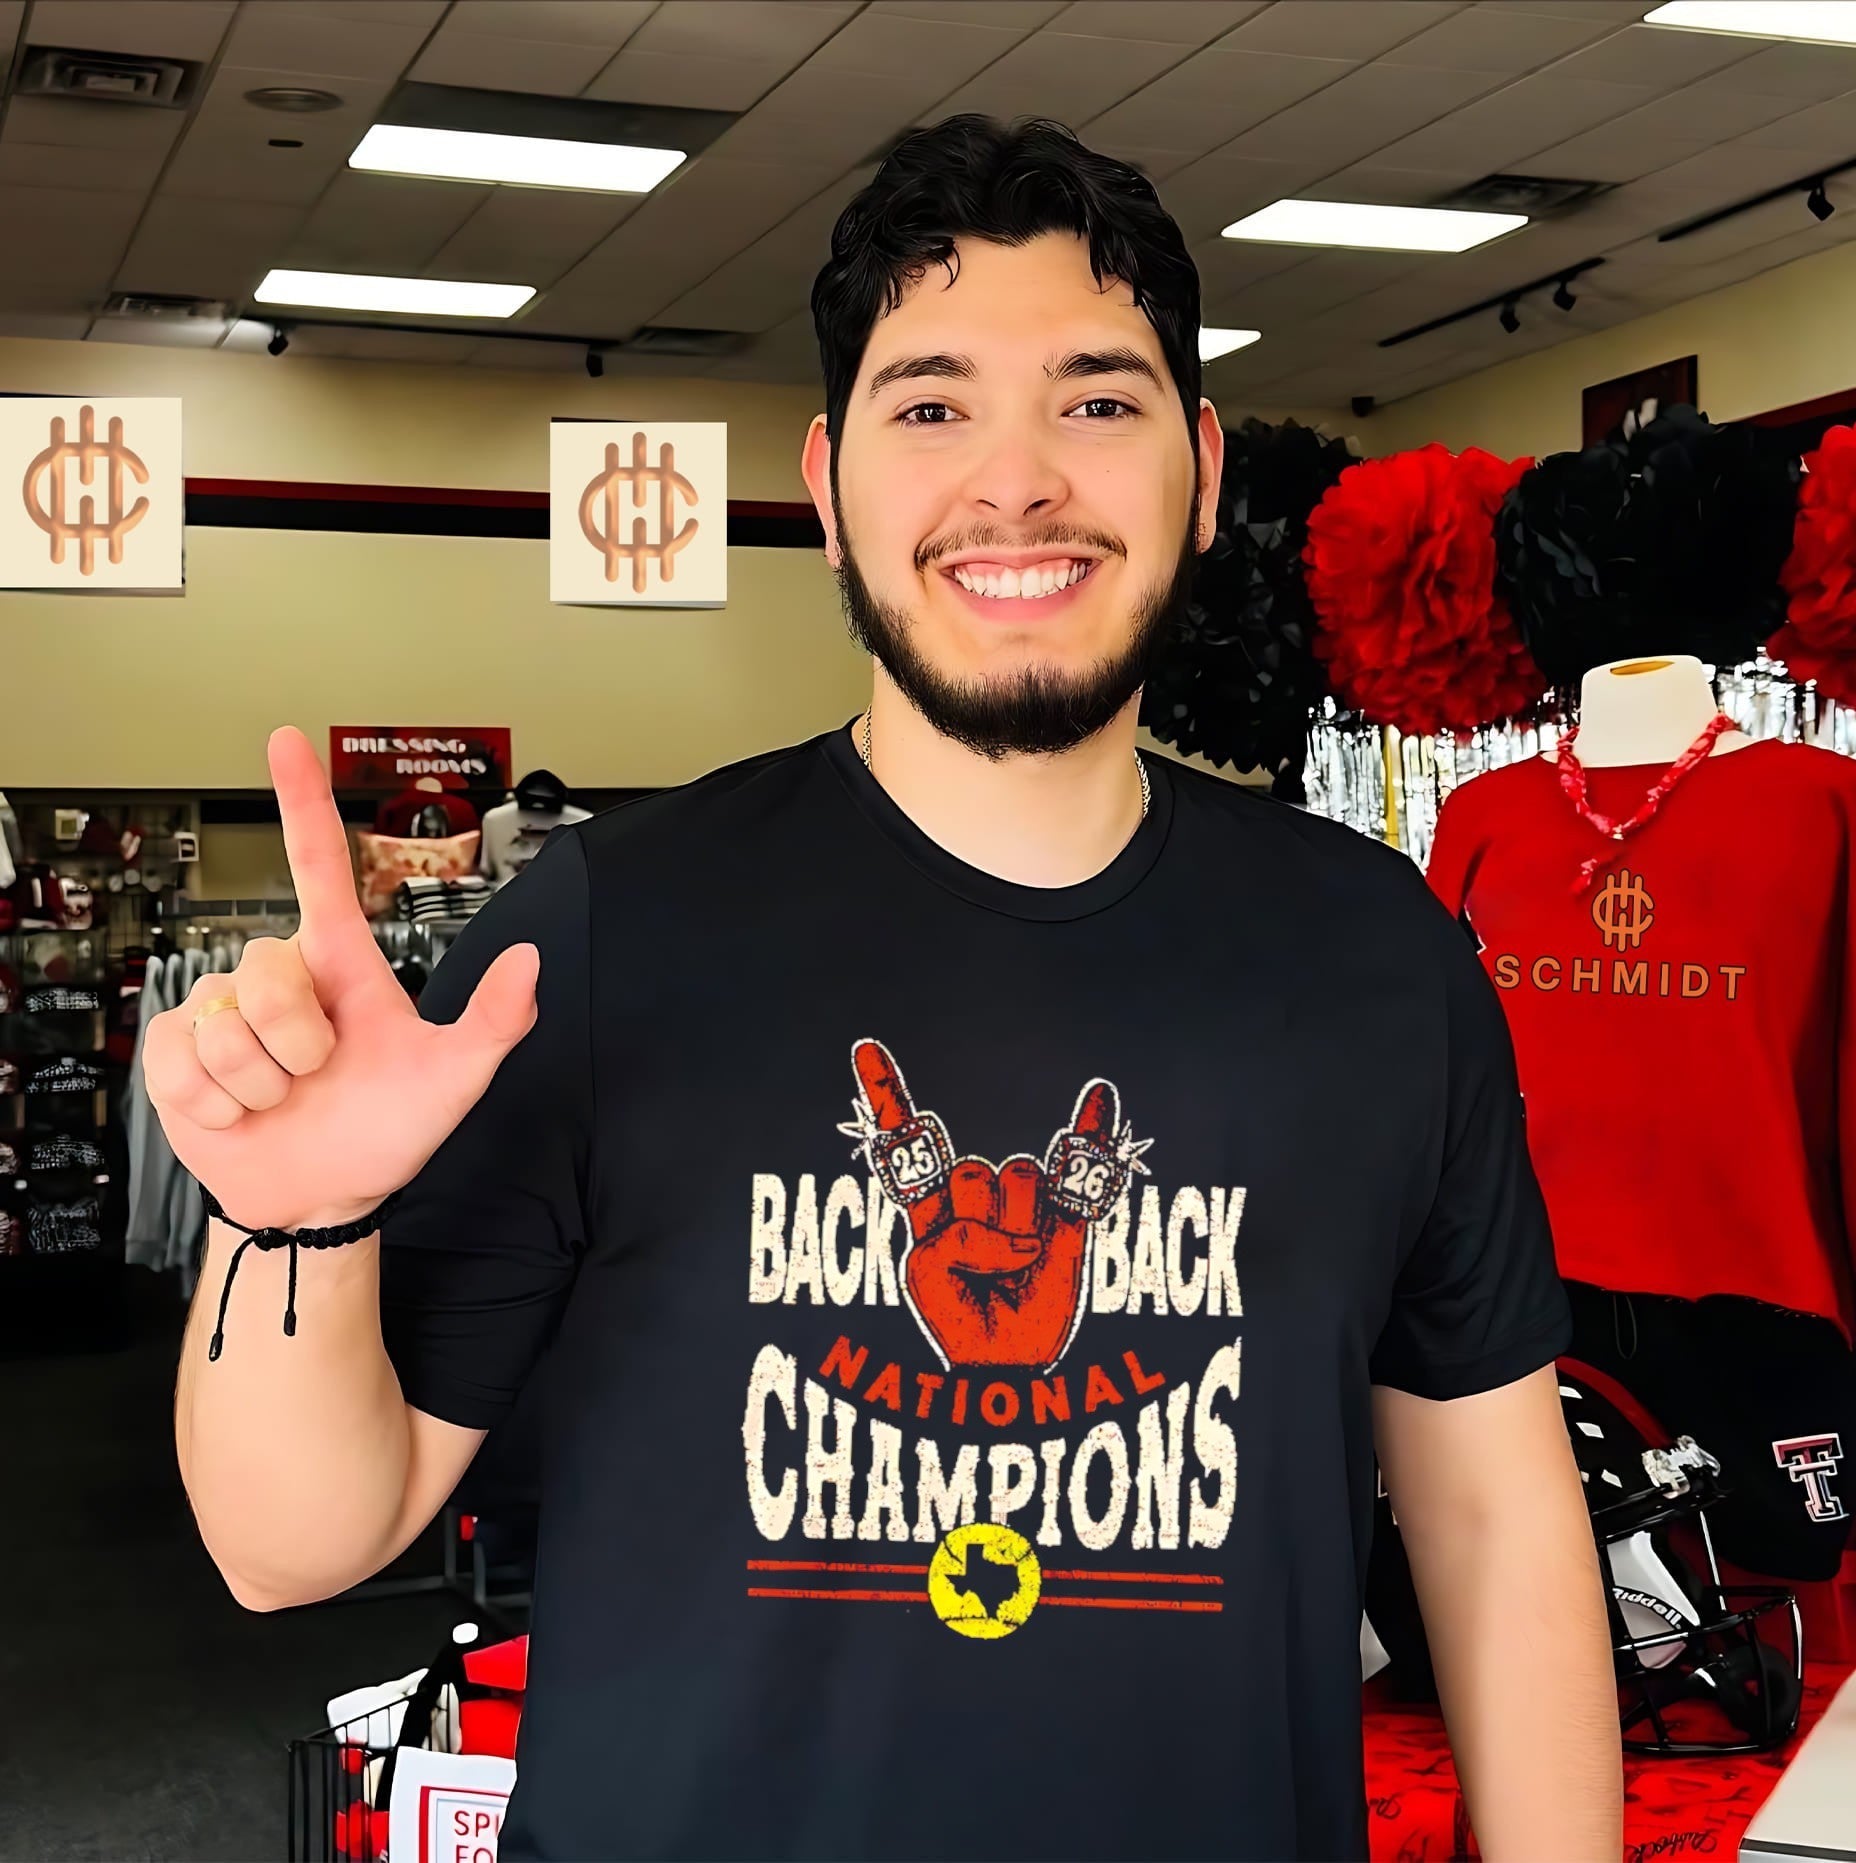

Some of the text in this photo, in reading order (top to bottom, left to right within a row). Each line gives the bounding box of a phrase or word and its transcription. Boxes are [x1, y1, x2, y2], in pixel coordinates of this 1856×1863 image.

[1494, 954, 1747, 1000] SCHMIDT
[891, 1138, 936, 1183] 25
[1063, 1156, 1110, 1200] 26
[749, 1173, 1247, 1317] BACK BACK
[818, 1334, 1167, 1428] NATIONAL
[741, 1335, 1243, 1551] CHAMPIONS
